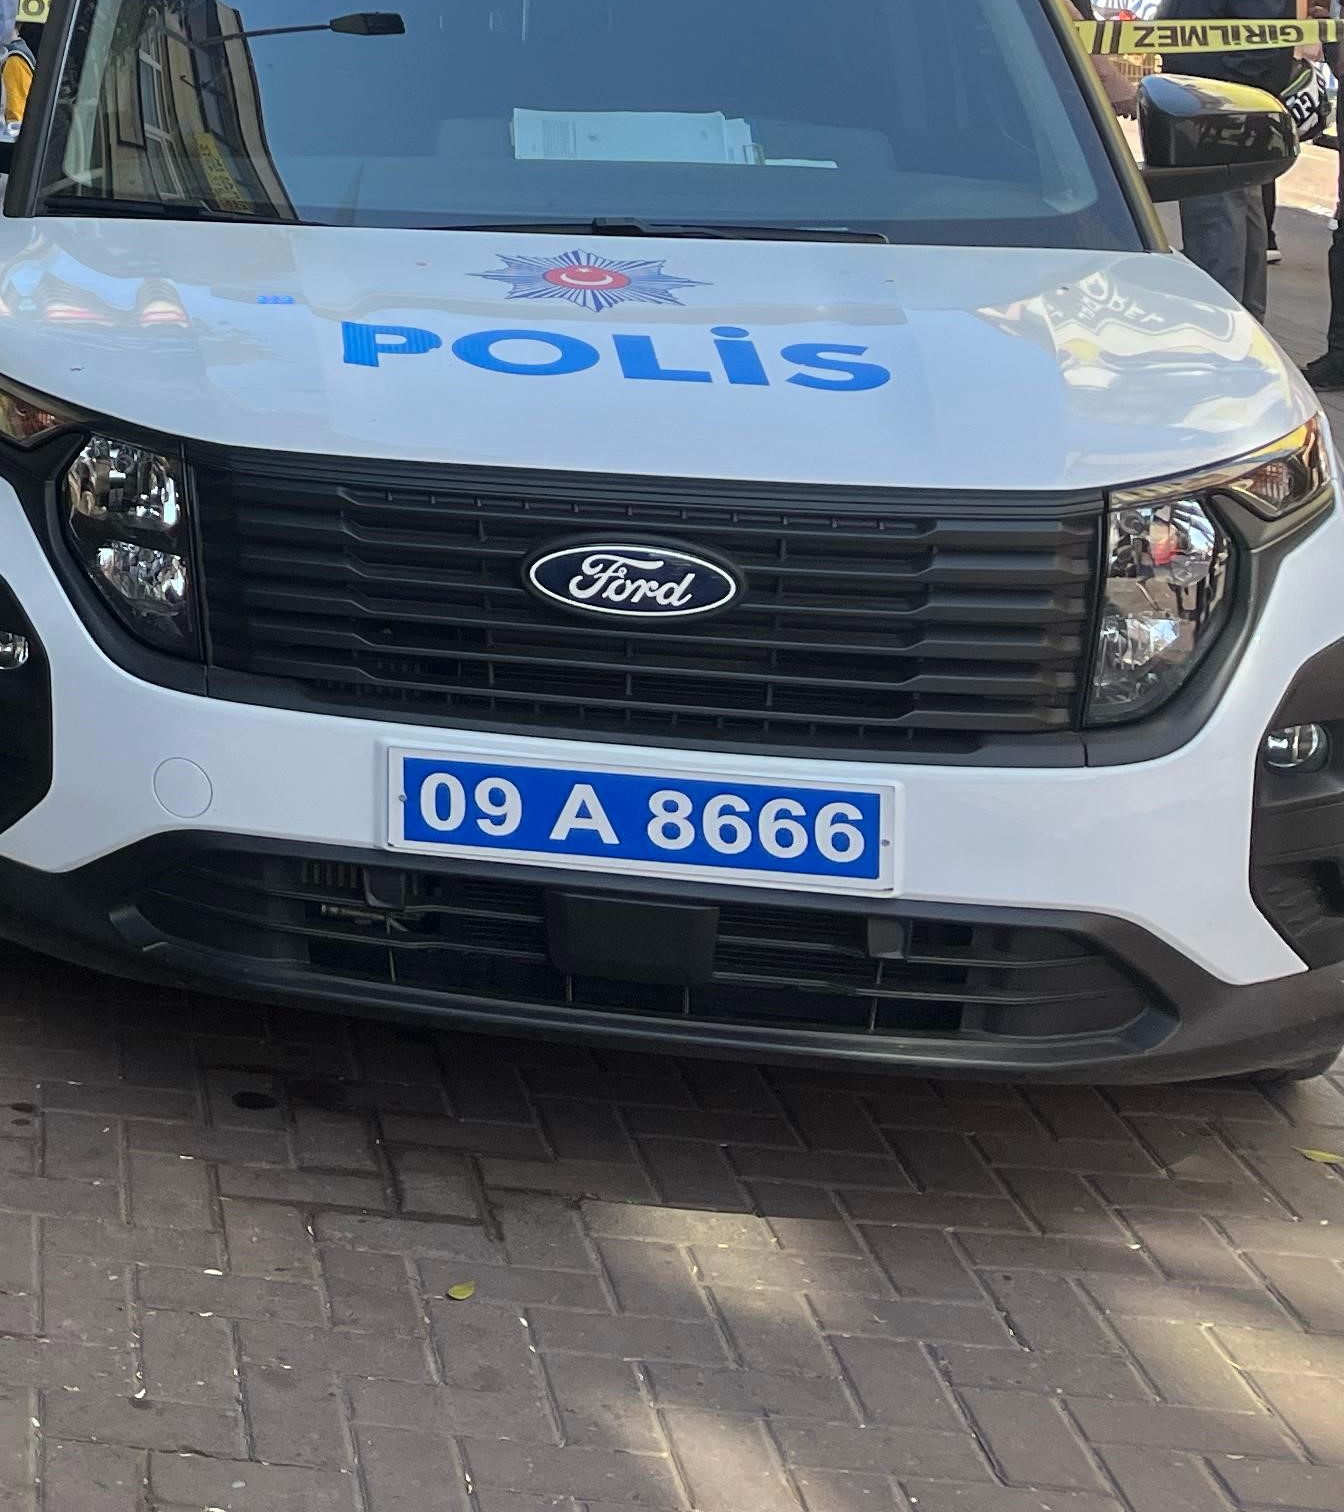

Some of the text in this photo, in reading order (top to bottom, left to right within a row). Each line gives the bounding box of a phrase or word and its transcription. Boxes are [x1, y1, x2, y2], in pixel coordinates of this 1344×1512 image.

[1134, 22, 1304, 48] GİRİLMEZ
[342, 320, 892, 392] POLİS
[568, 551, 694, 609] Ford
[419, 771, 866, 864] 09 A 8666
